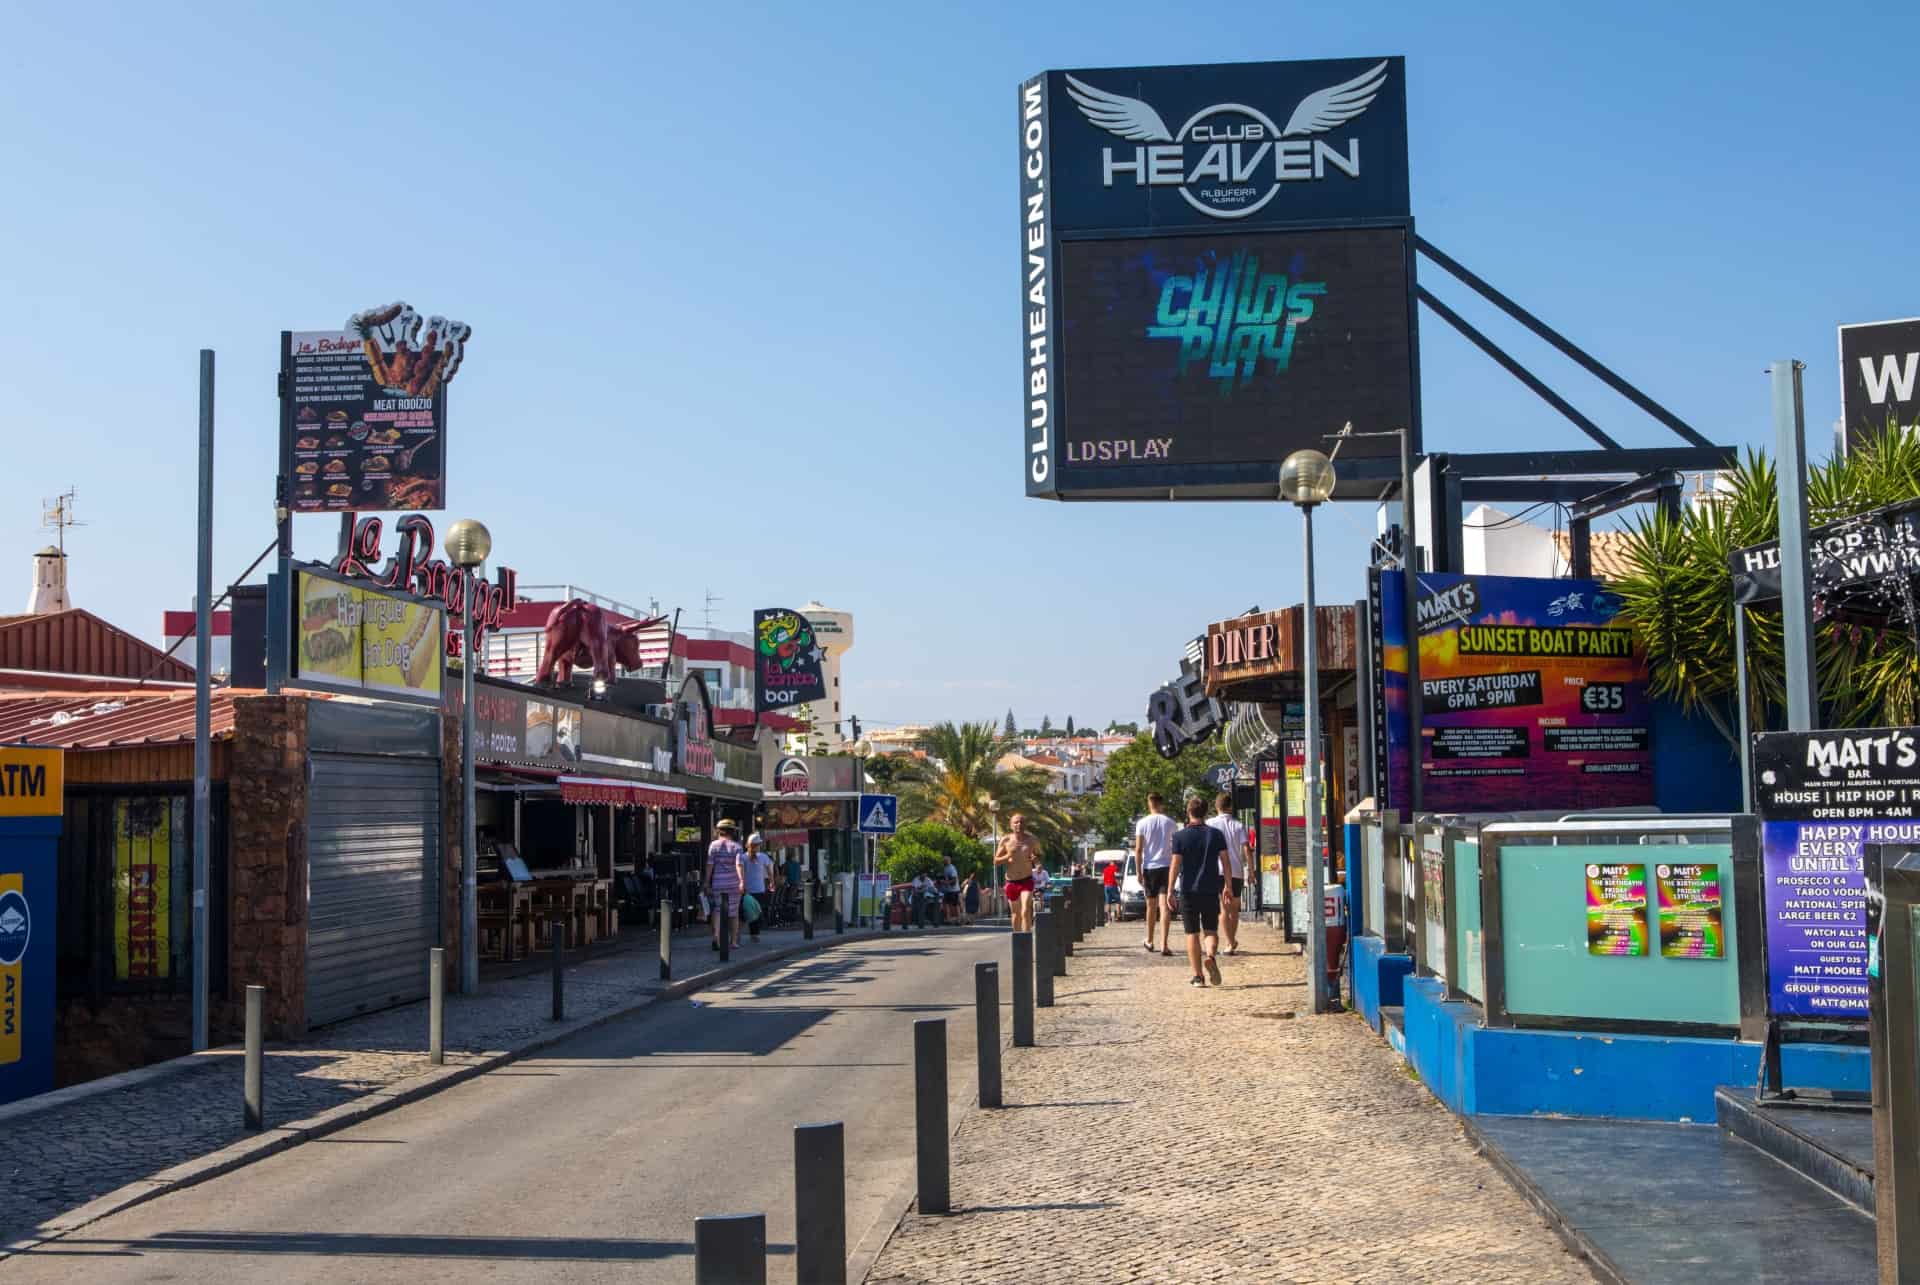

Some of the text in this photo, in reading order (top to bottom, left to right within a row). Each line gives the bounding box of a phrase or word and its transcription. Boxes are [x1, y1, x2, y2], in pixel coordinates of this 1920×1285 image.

[1192, 124, 1264, 142] CLUB
[1102, 138, 1360, 186] HEAVEN
[1200, 187, 1256, 198] ALBUFEIRA
[1024, 82, 1049, 484] CLUBHEAVEN.COM
[374, 399, 396, 411] MEAT
[1066, 438, 1173, 462] LDSPLAY
[1744, 547, 1782, 572] HI
[1417, 583, 1475, 621] MATT'S
[1212, 624, 1275, 667] DINER
[1460, 627, 1632, 655] SUNSET BOAT PARTY
[1423, 673, 1536, 695] EVERY SATURDAY
[1564, 677, 1585, 686] PRICE
[765, 689, 799, 703] bar
[1448, 693, 1477, 708] 6PM
[1487, 690, 1516, 705] 9PM
[1583, 686, 1623, 709] €35
[1807, 731, 1917, 768] MATT'S
[1848, 769, 1871, 778] BAR
[1774, 791, 1820, 803] HOUSE
[1836, 791, 1861, 802] HIP
[1866, 790, 1895, 801] HOP
[1812, 808, 1845, 818] OPEN
[1848, 807, 1874, 817] 8PM
[1886, 806, 1912, 817] 4AM
[1801, 826, 1863, 840] HAPPY
[1800, 841, 1859, 856] EVERY
[1791, 857, 1849, 871] UNTIL
[1777, 877, 1846, 885] PROSECCO €4
[1796, 888, 1829, 896] TABOO
[1785, 900, 1837, 909] NATIONAL
[1779, 912, 1857, 920] LARGE BEER €2
[1804, 928, 1836, 936] WATCH
[1794, 966, 1862, 975] MATT MOORE
[1785, 984, 1820, 993] GROUP
[5, 975, 15, 1035] ATM
